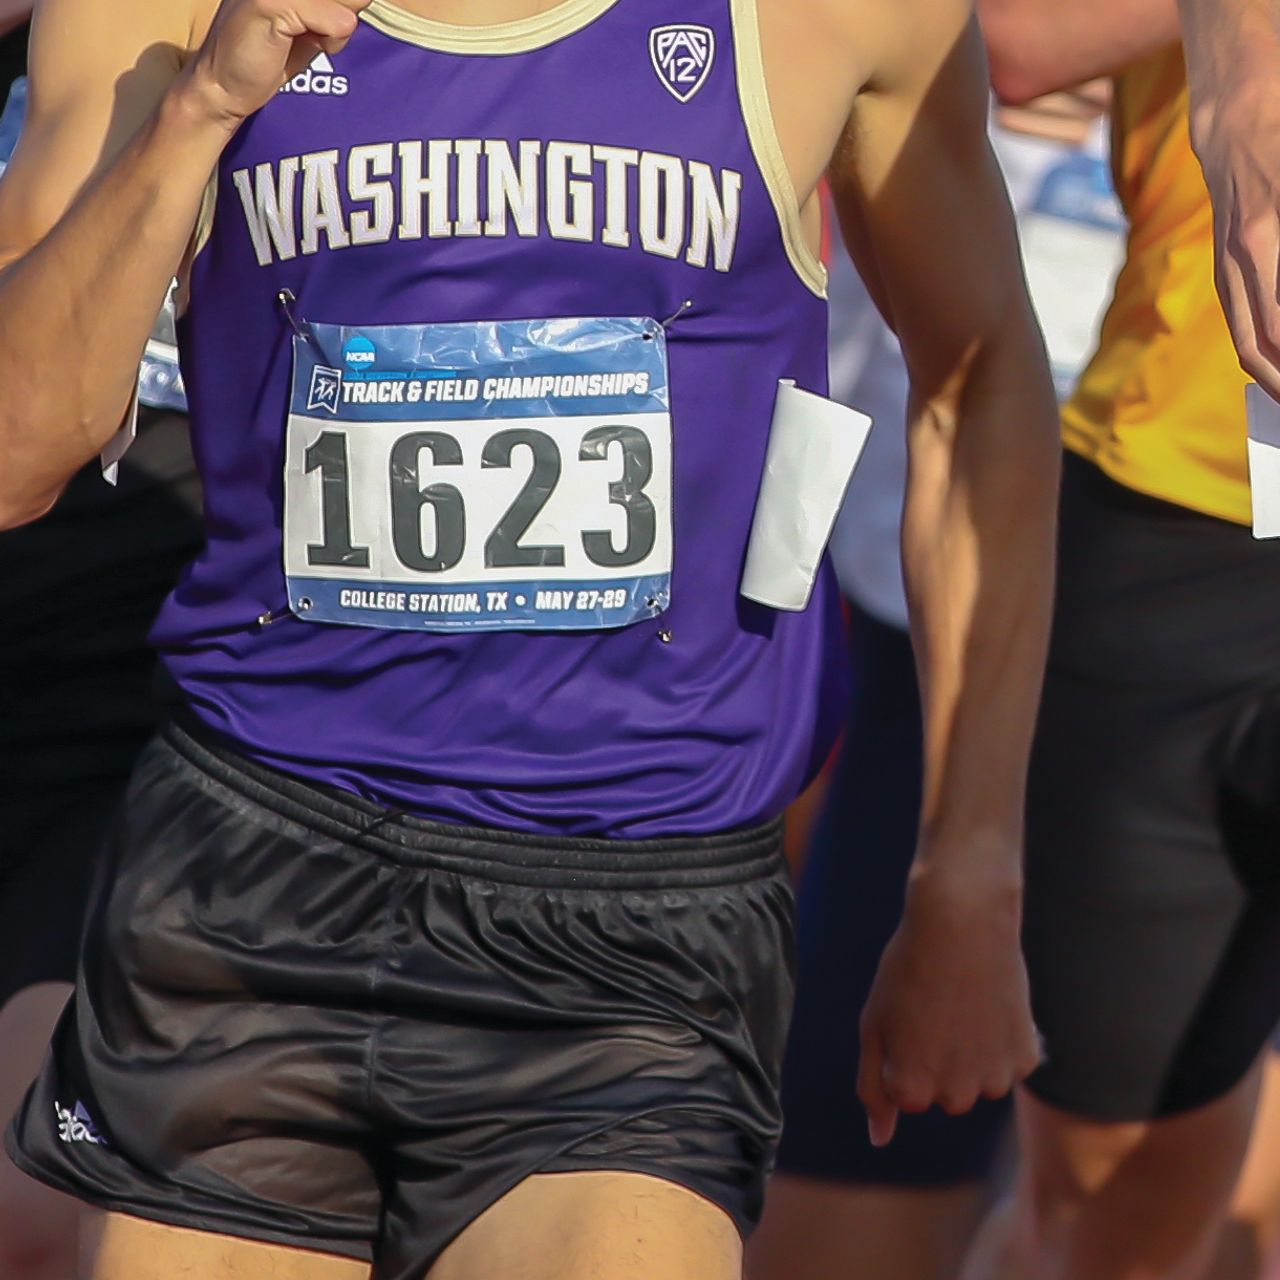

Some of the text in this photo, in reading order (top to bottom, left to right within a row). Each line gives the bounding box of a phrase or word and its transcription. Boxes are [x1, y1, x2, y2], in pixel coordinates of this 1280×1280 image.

[657, 30, 707, 69] PAC
[669, 57, 697, 82] 12
[232, 138, 742, 272] WASHINGTON
[342, 380, 405, 403] TRACK
[406, 380, 423, 403] &
[424, 378, 479, 402] FIELD
[482, 371, 649, 401] CHAMPIONSHIPS
[303, 424, 656, 572] 1623
[340, 588, 627, 614] COLLEGE STATION, TX MAY 27-29
